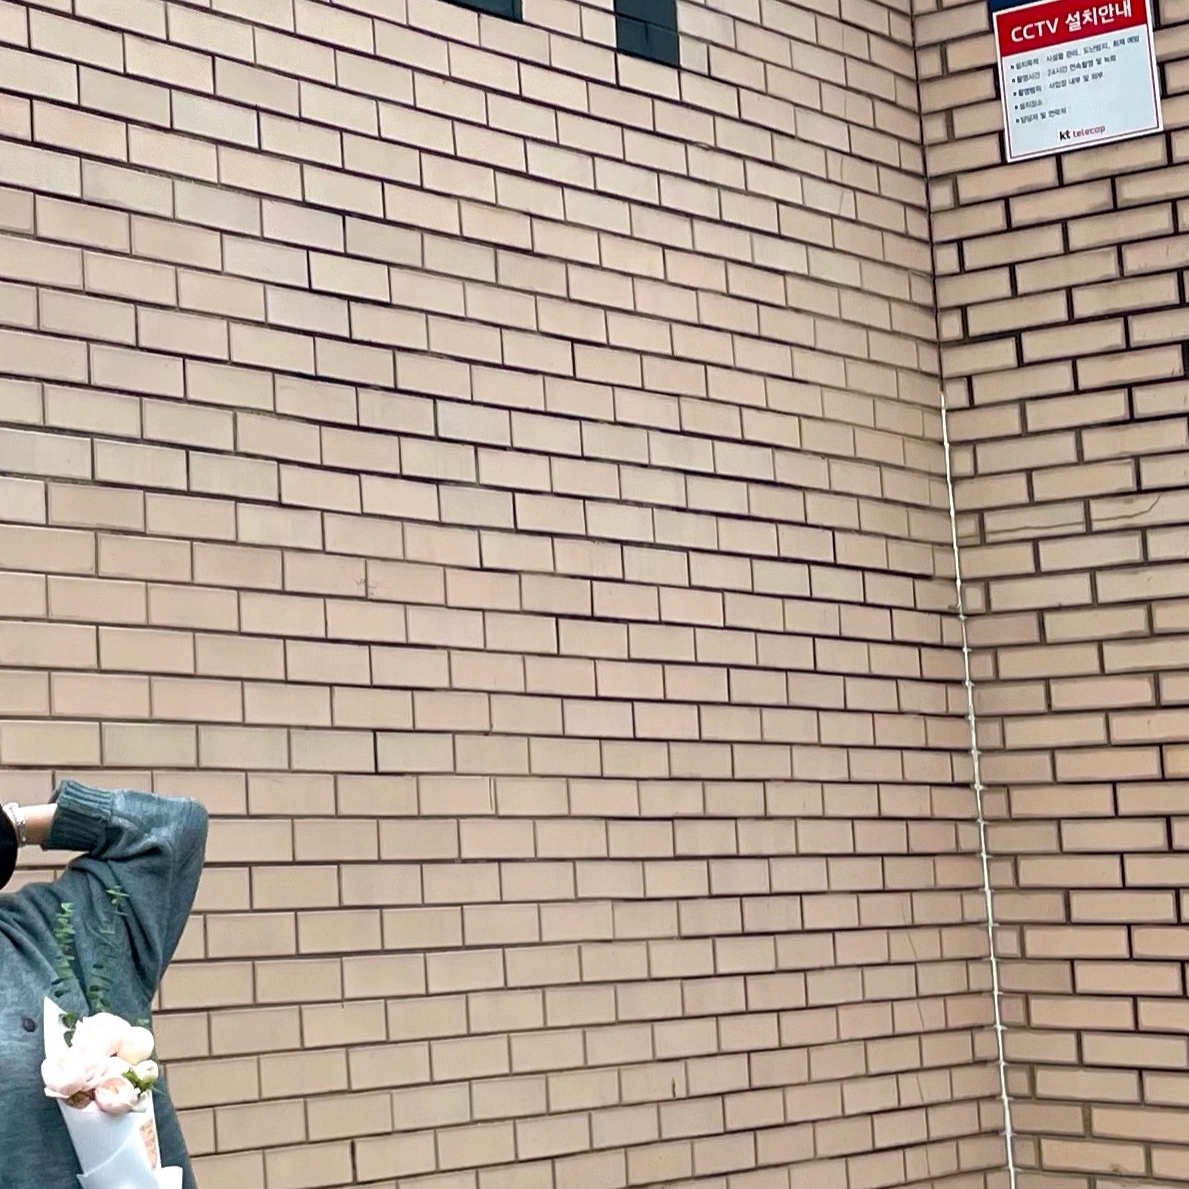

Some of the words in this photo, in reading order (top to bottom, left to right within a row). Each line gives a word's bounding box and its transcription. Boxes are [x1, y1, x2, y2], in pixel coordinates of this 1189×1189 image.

[1010, 17, 1059, 42] CCTV
[1065, 0, 1132, 32] 설치안내
[1059, 129, 1071, 140] kt
[1072, 125, 1106, 138] telecop
